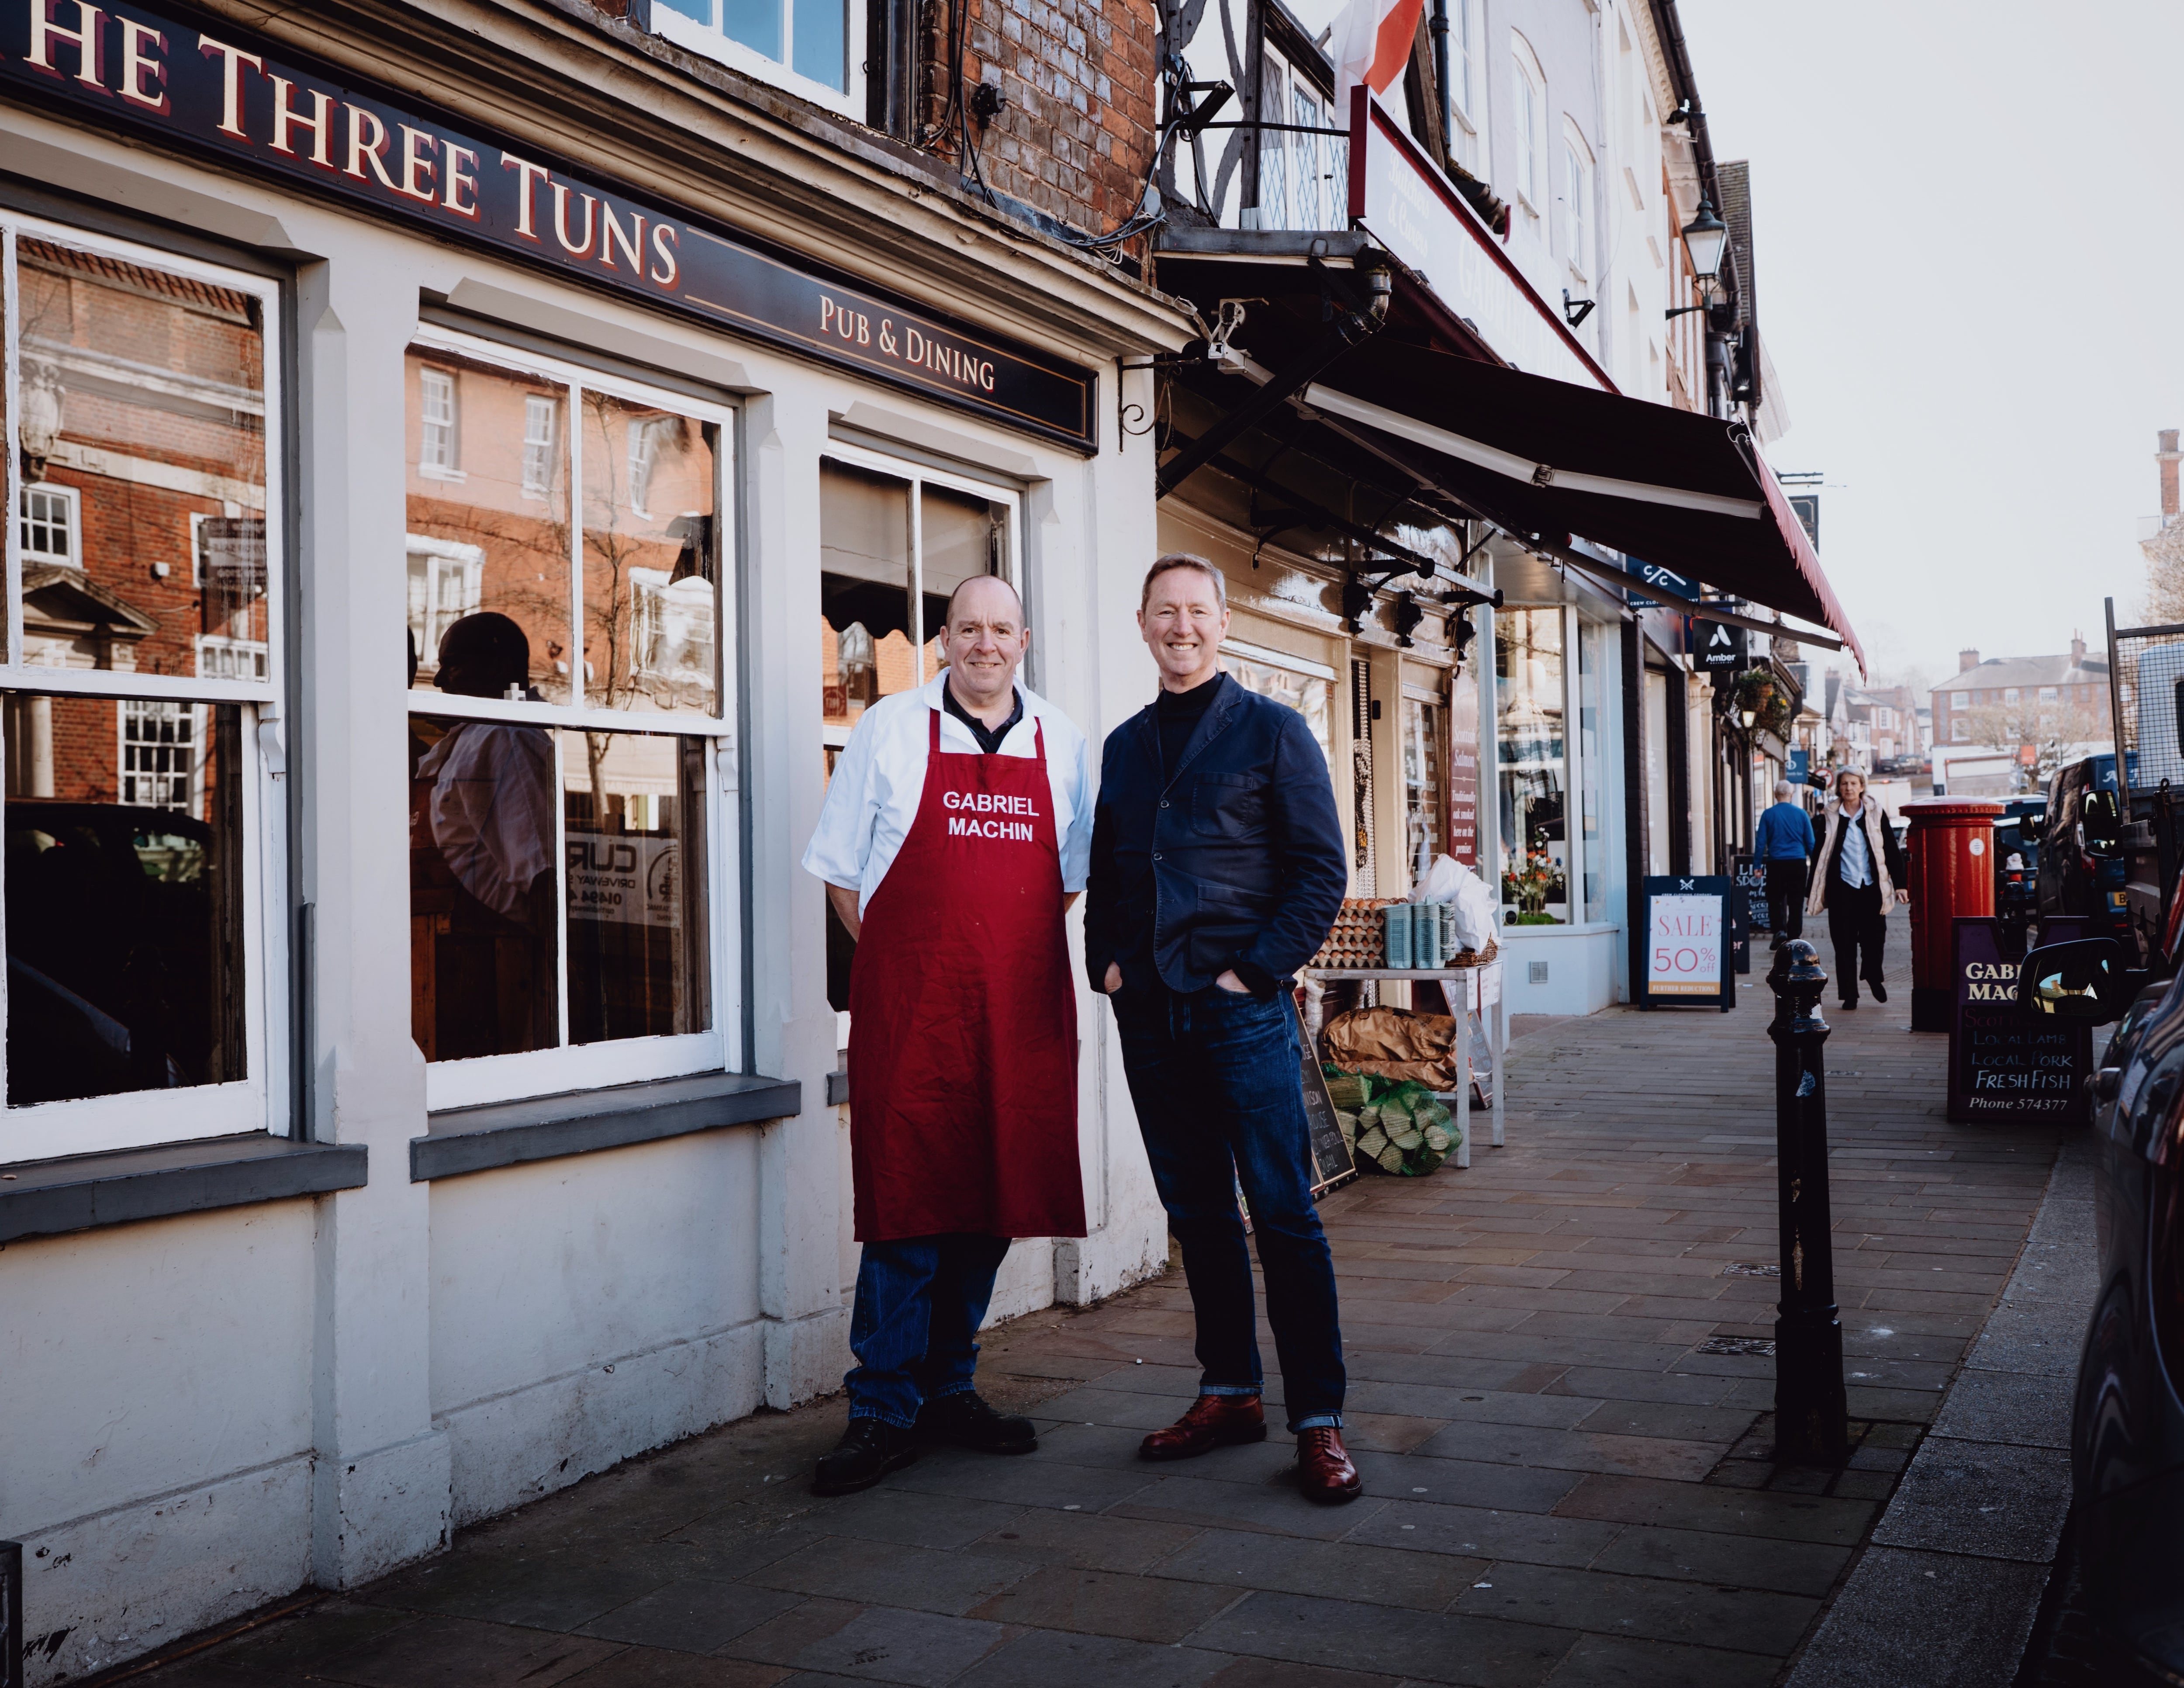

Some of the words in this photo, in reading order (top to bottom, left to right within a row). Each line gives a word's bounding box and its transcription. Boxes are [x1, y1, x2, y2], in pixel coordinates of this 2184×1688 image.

[198, 33, 477, 218] THREE
[501, 151, 677, 285] TUNS
[1388, 192, 1397, 228] &
[819, 295, 870, 345] PUB
[879, 319, 899, 356] &
[905, 327, 995, 391] DINING
[1706, 654, 1736, 662] Amber
[1454, 725, 1475, 743] Scottish
[1454, 749, 1475, 768] Salmon
[943, 791, 1040, 816] GABRIEL
[1452, 790, 1476, 805] Traditionally
[1461, 809, 1474, 820] smoked
[948, 817, 1033, 842] MACHIN
[1453, 826, 1462, 837] here
[1462, 828, 1467, 837] on
[1455, 842, 1472, 857] premises
[1659, 915, 1712, 936] SALE
[1700, 962, 1716, 972] off
[1974, 1031, 2024, 1045] LOCAL
[2027, 1030, 2067, 1045] LAMB
[1971, 1053, 2027, 1066] LOCAL
[2032, 1050, 2073, 1068] PORK
[1976, 1070, 2028, 1089] FRESH
[2032, 1070, 2070, 1090] FISH
[1969, 1097, 2014, 1109] Phone
[2016, 1099, 2068, 1111] 574377
